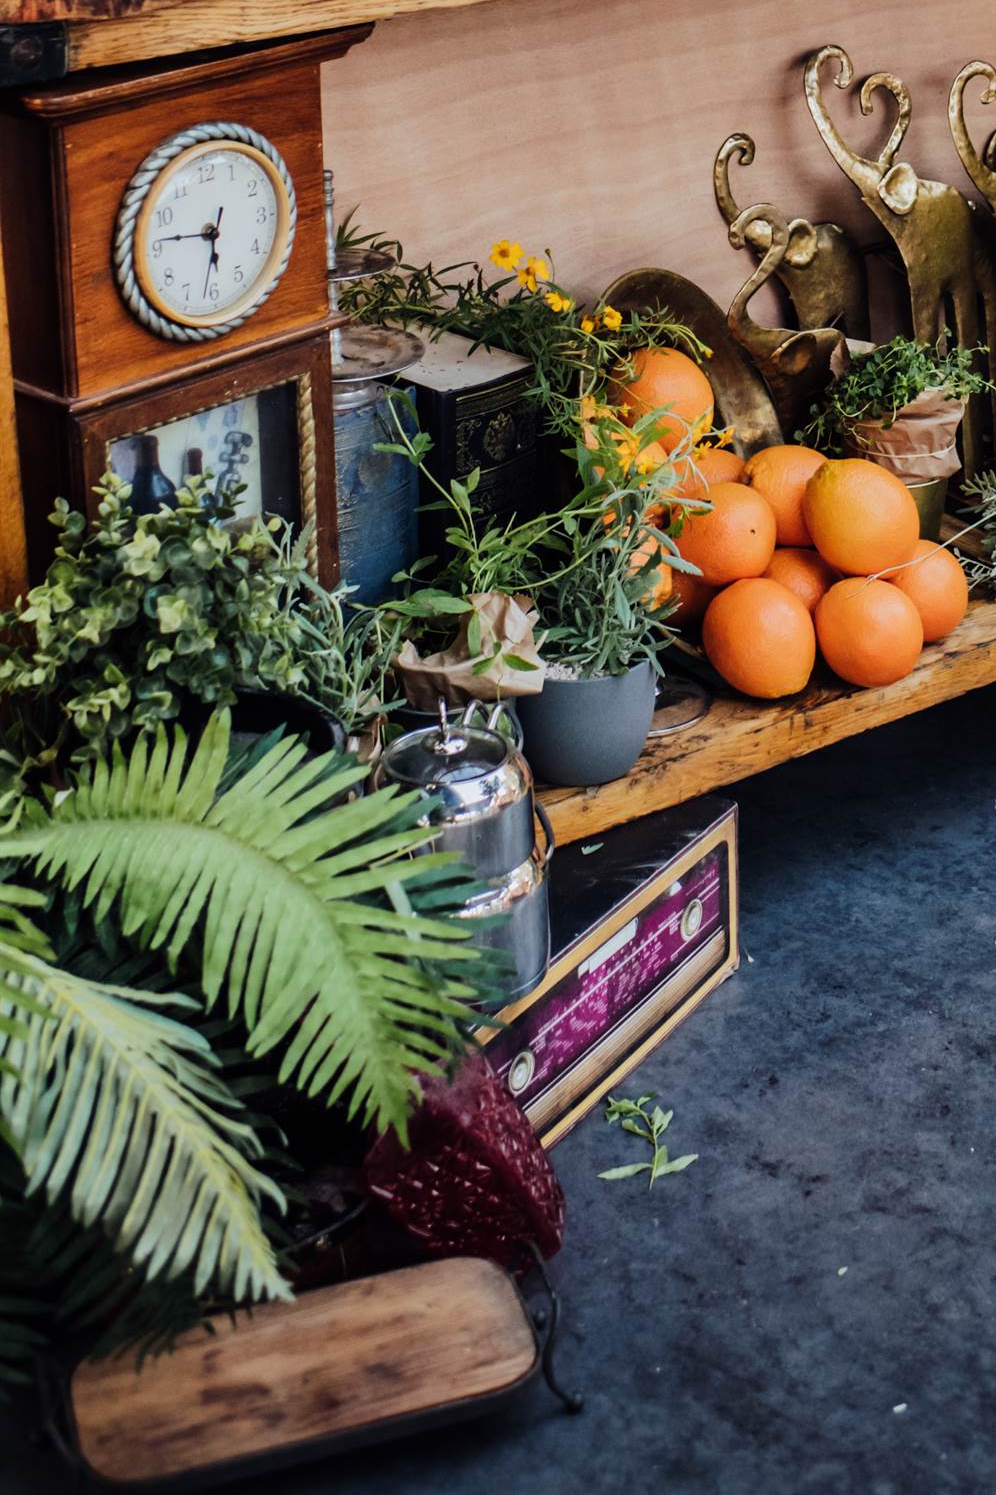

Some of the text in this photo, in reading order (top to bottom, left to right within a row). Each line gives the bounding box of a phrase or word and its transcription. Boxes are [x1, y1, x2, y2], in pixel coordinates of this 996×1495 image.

[197, 164, 216, 185] 12
[228, 164, 236, 181] 1
[174, 186, 188, 200] 11
[247, 180, 258, 197] 2
[155, 207, 173, 228] 10
[256, 207, 267, 224] 3
[152, 239, 163, 258] 9
[250, 238, 260, 255] 4
[163, 267, 175, 285] 8
[233, 265, 244, 282] 5
[182, 283, 190, 301] 7
[209, 282, 219, 301] 6
